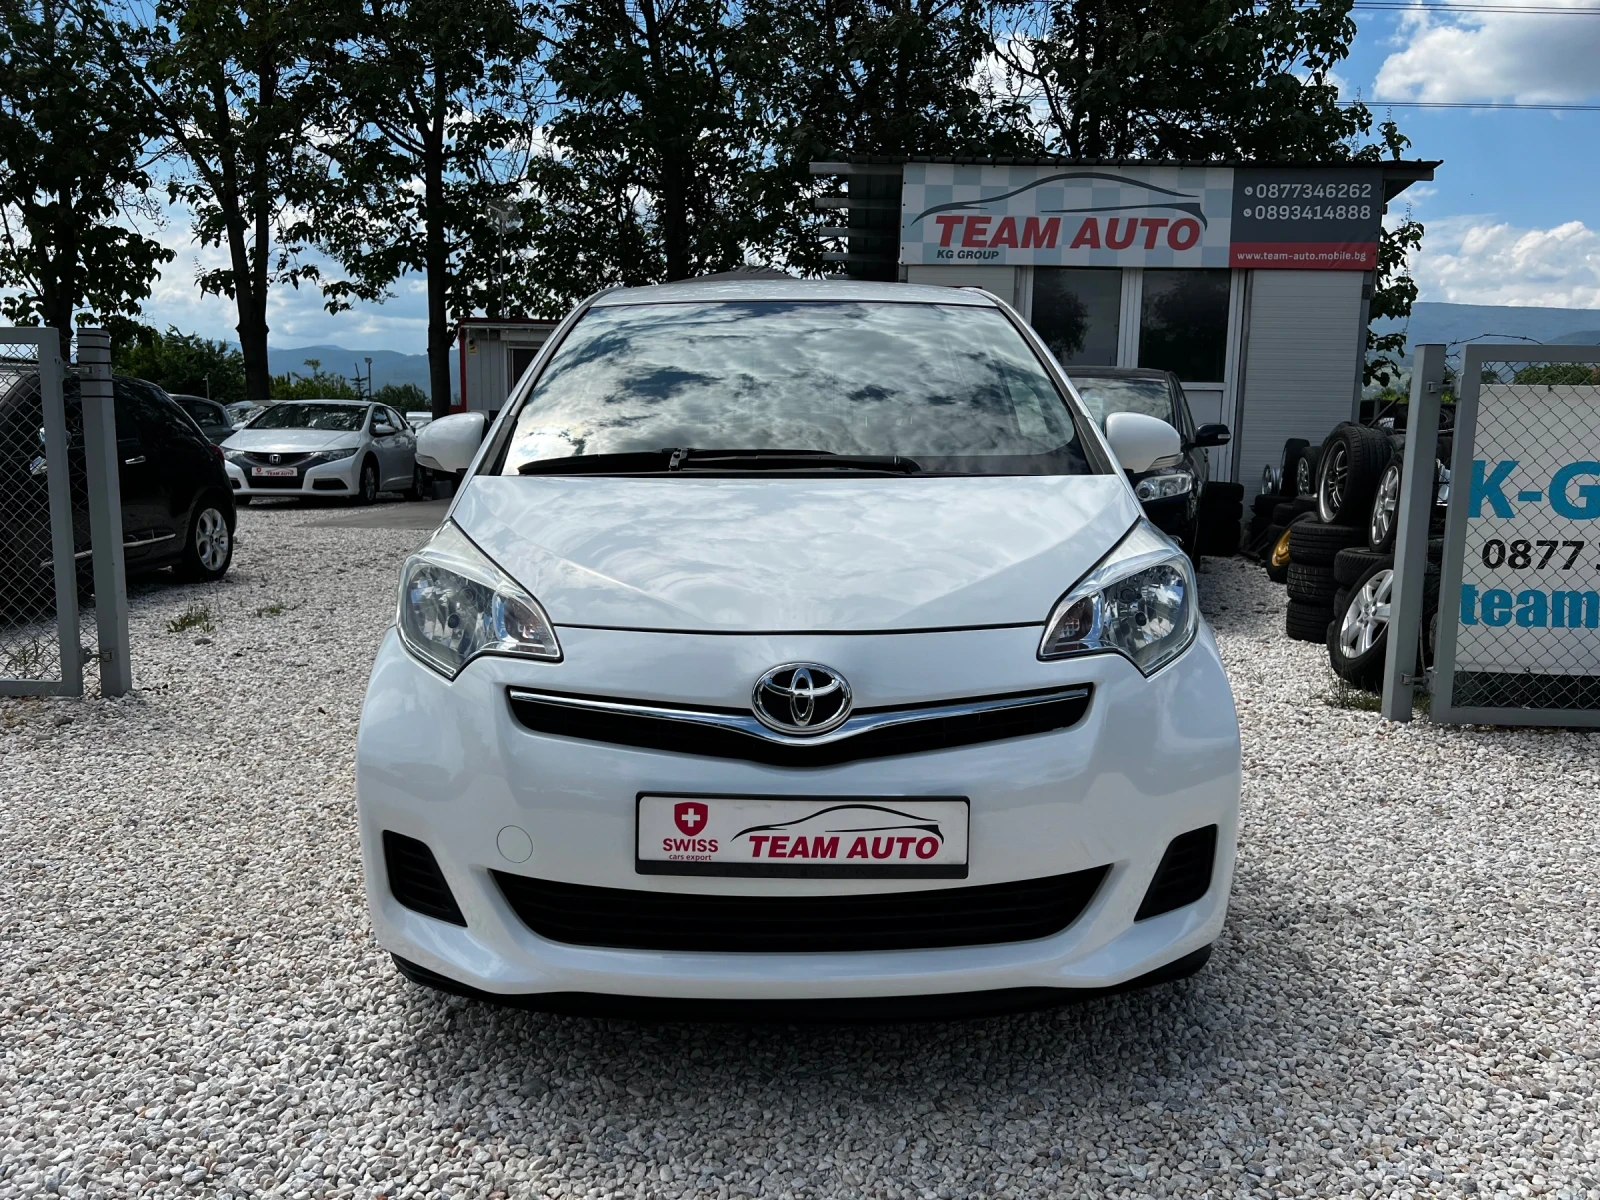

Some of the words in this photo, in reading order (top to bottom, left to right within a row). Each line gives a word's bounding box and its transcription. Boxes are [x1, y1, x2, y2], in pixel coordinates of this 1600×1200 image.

[1256, 183, 1372, 198] 0877346262
[1255, 205, 1371, 220] 0893414888
[935, 215, 1061, 249] TEAM
[1070, 217, 1200, 251] AUTO
[936, 250, 954, 259] KG
[957, 250, 999, 260] GROUP
[1237, 251, 1366, 262] www.team-auto.mobile.bg
[1481, 539, 1585, 570] 0877
[1460, 584, 1600, 629] team
[662, 838, 719, 853] SWISS
[749, 835, 840, 859] TEAM
[846, 836, 940, 860] AUTO
[668, 853, 685, 861] cars
[685, 853, 712, 862] export
